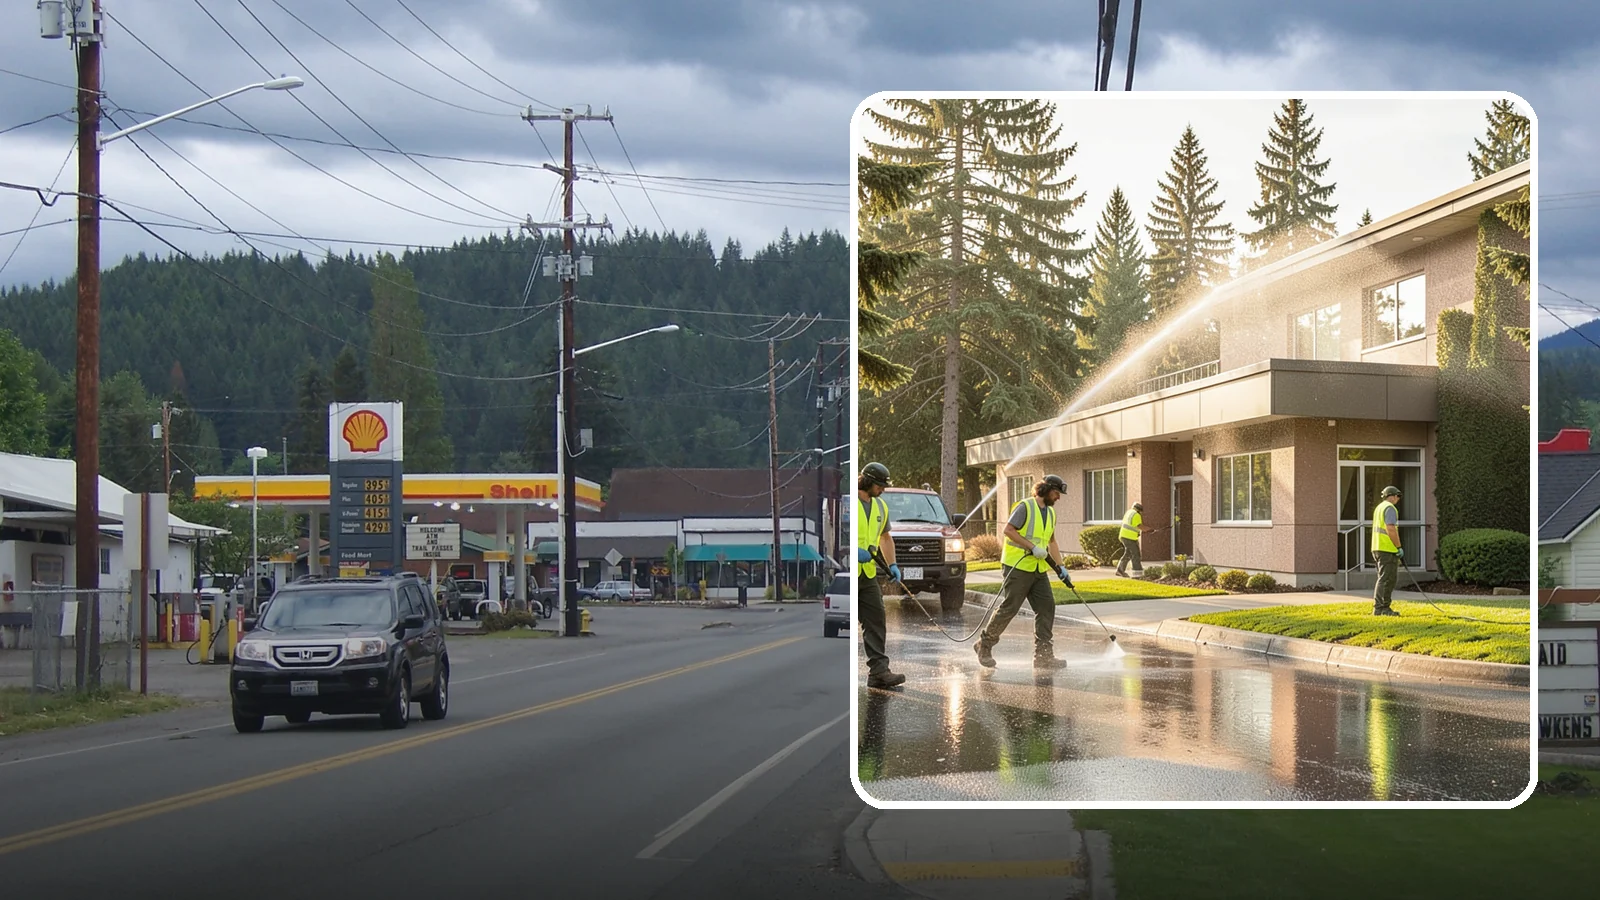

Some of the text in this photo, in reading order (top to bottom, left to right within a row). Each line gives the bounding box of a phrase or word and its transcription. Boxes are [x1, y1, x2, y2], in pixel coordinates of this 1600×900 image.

[366, 480, 383, 490] 395
[490, 484, 547, 499] Shell
[366, 494, 383, 504] 405
[366, 508, 383, 518] 415
[366, 522, 383, 533] 429
[1539, 643, 1567, 665] AID
